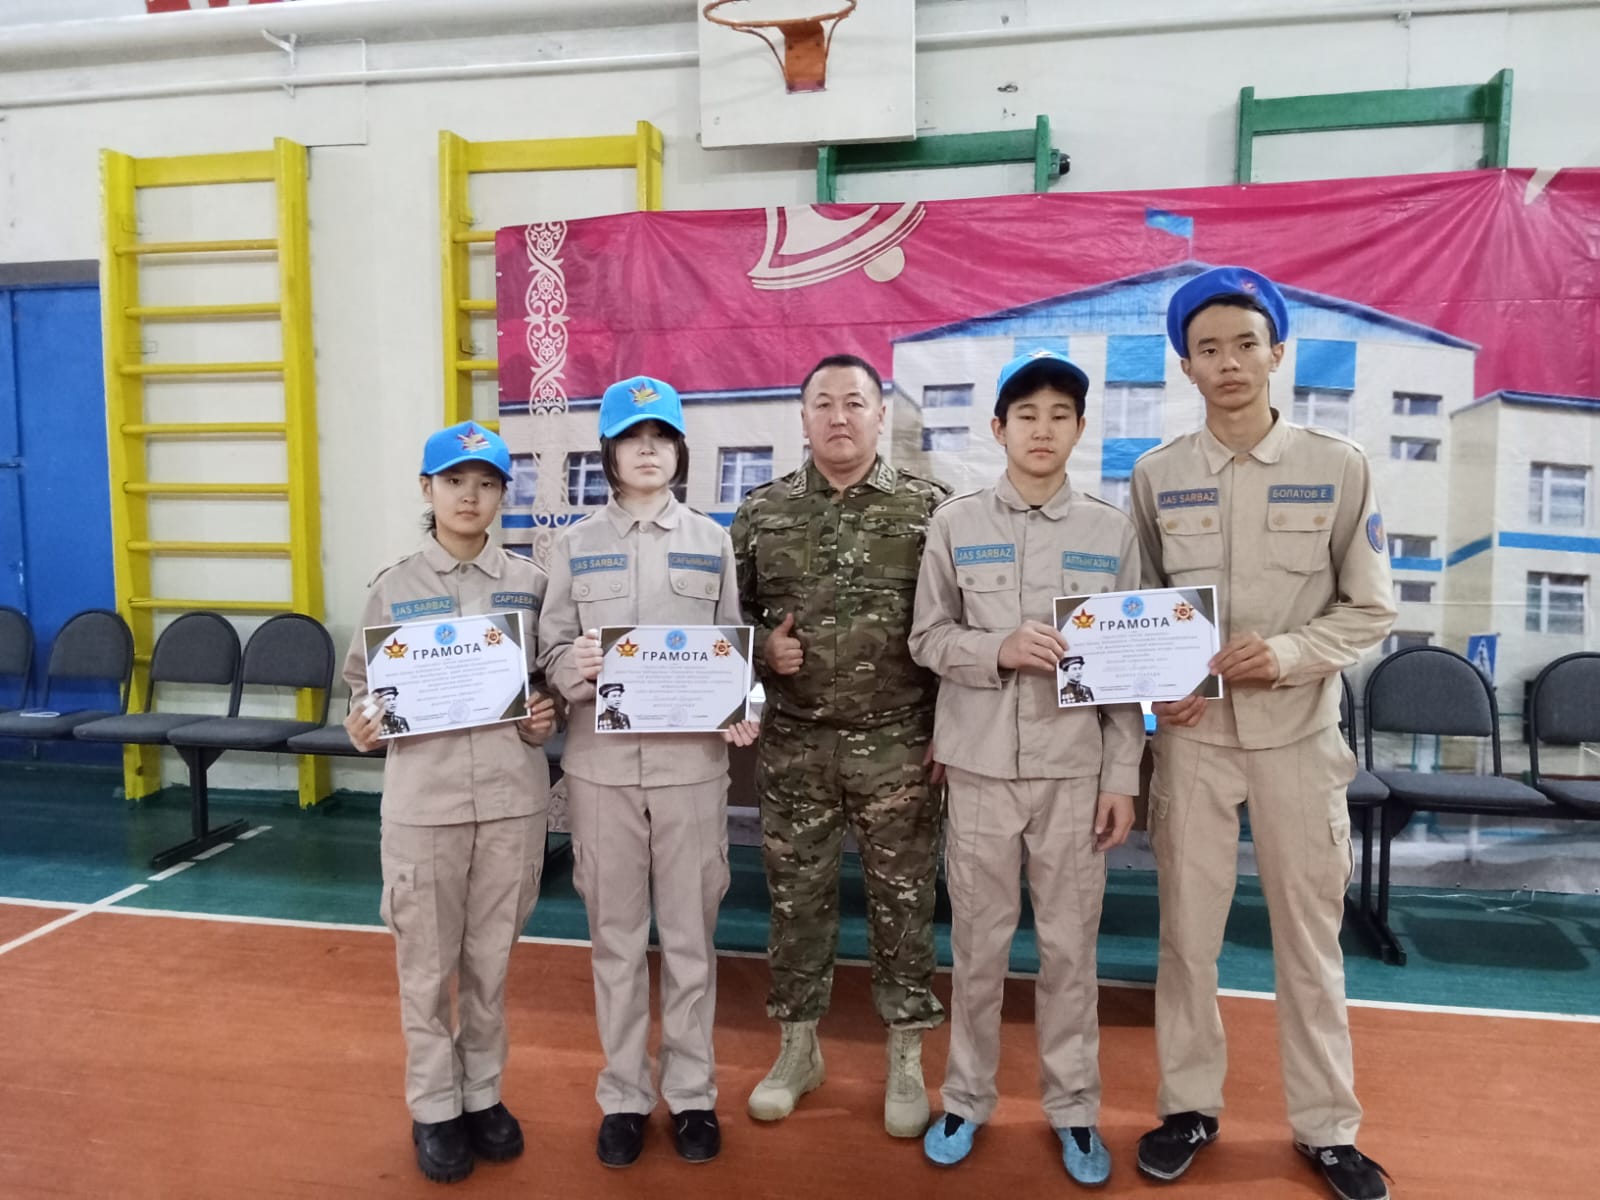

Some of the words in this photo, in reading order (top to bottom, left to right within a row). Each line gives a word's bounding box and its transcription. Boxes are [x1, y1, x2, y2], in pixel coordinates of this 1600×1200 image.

[1179, 490, 1217, 503] SARBAZ
[957, 550, 974, 562] JAS
[976, 548, 1012, 560] SARBAZ
[590, 557, 626, 569] SARBAZ
[396, 606, 412, 616] JAS
[414, 599, 452, 612] SARBAZ
[1099, 616, 1170, 631] ГРАМОТА
[413, 642, 482, 660] ГРАМОТА
[642, 651, 709, 662] ГРАМОТА
